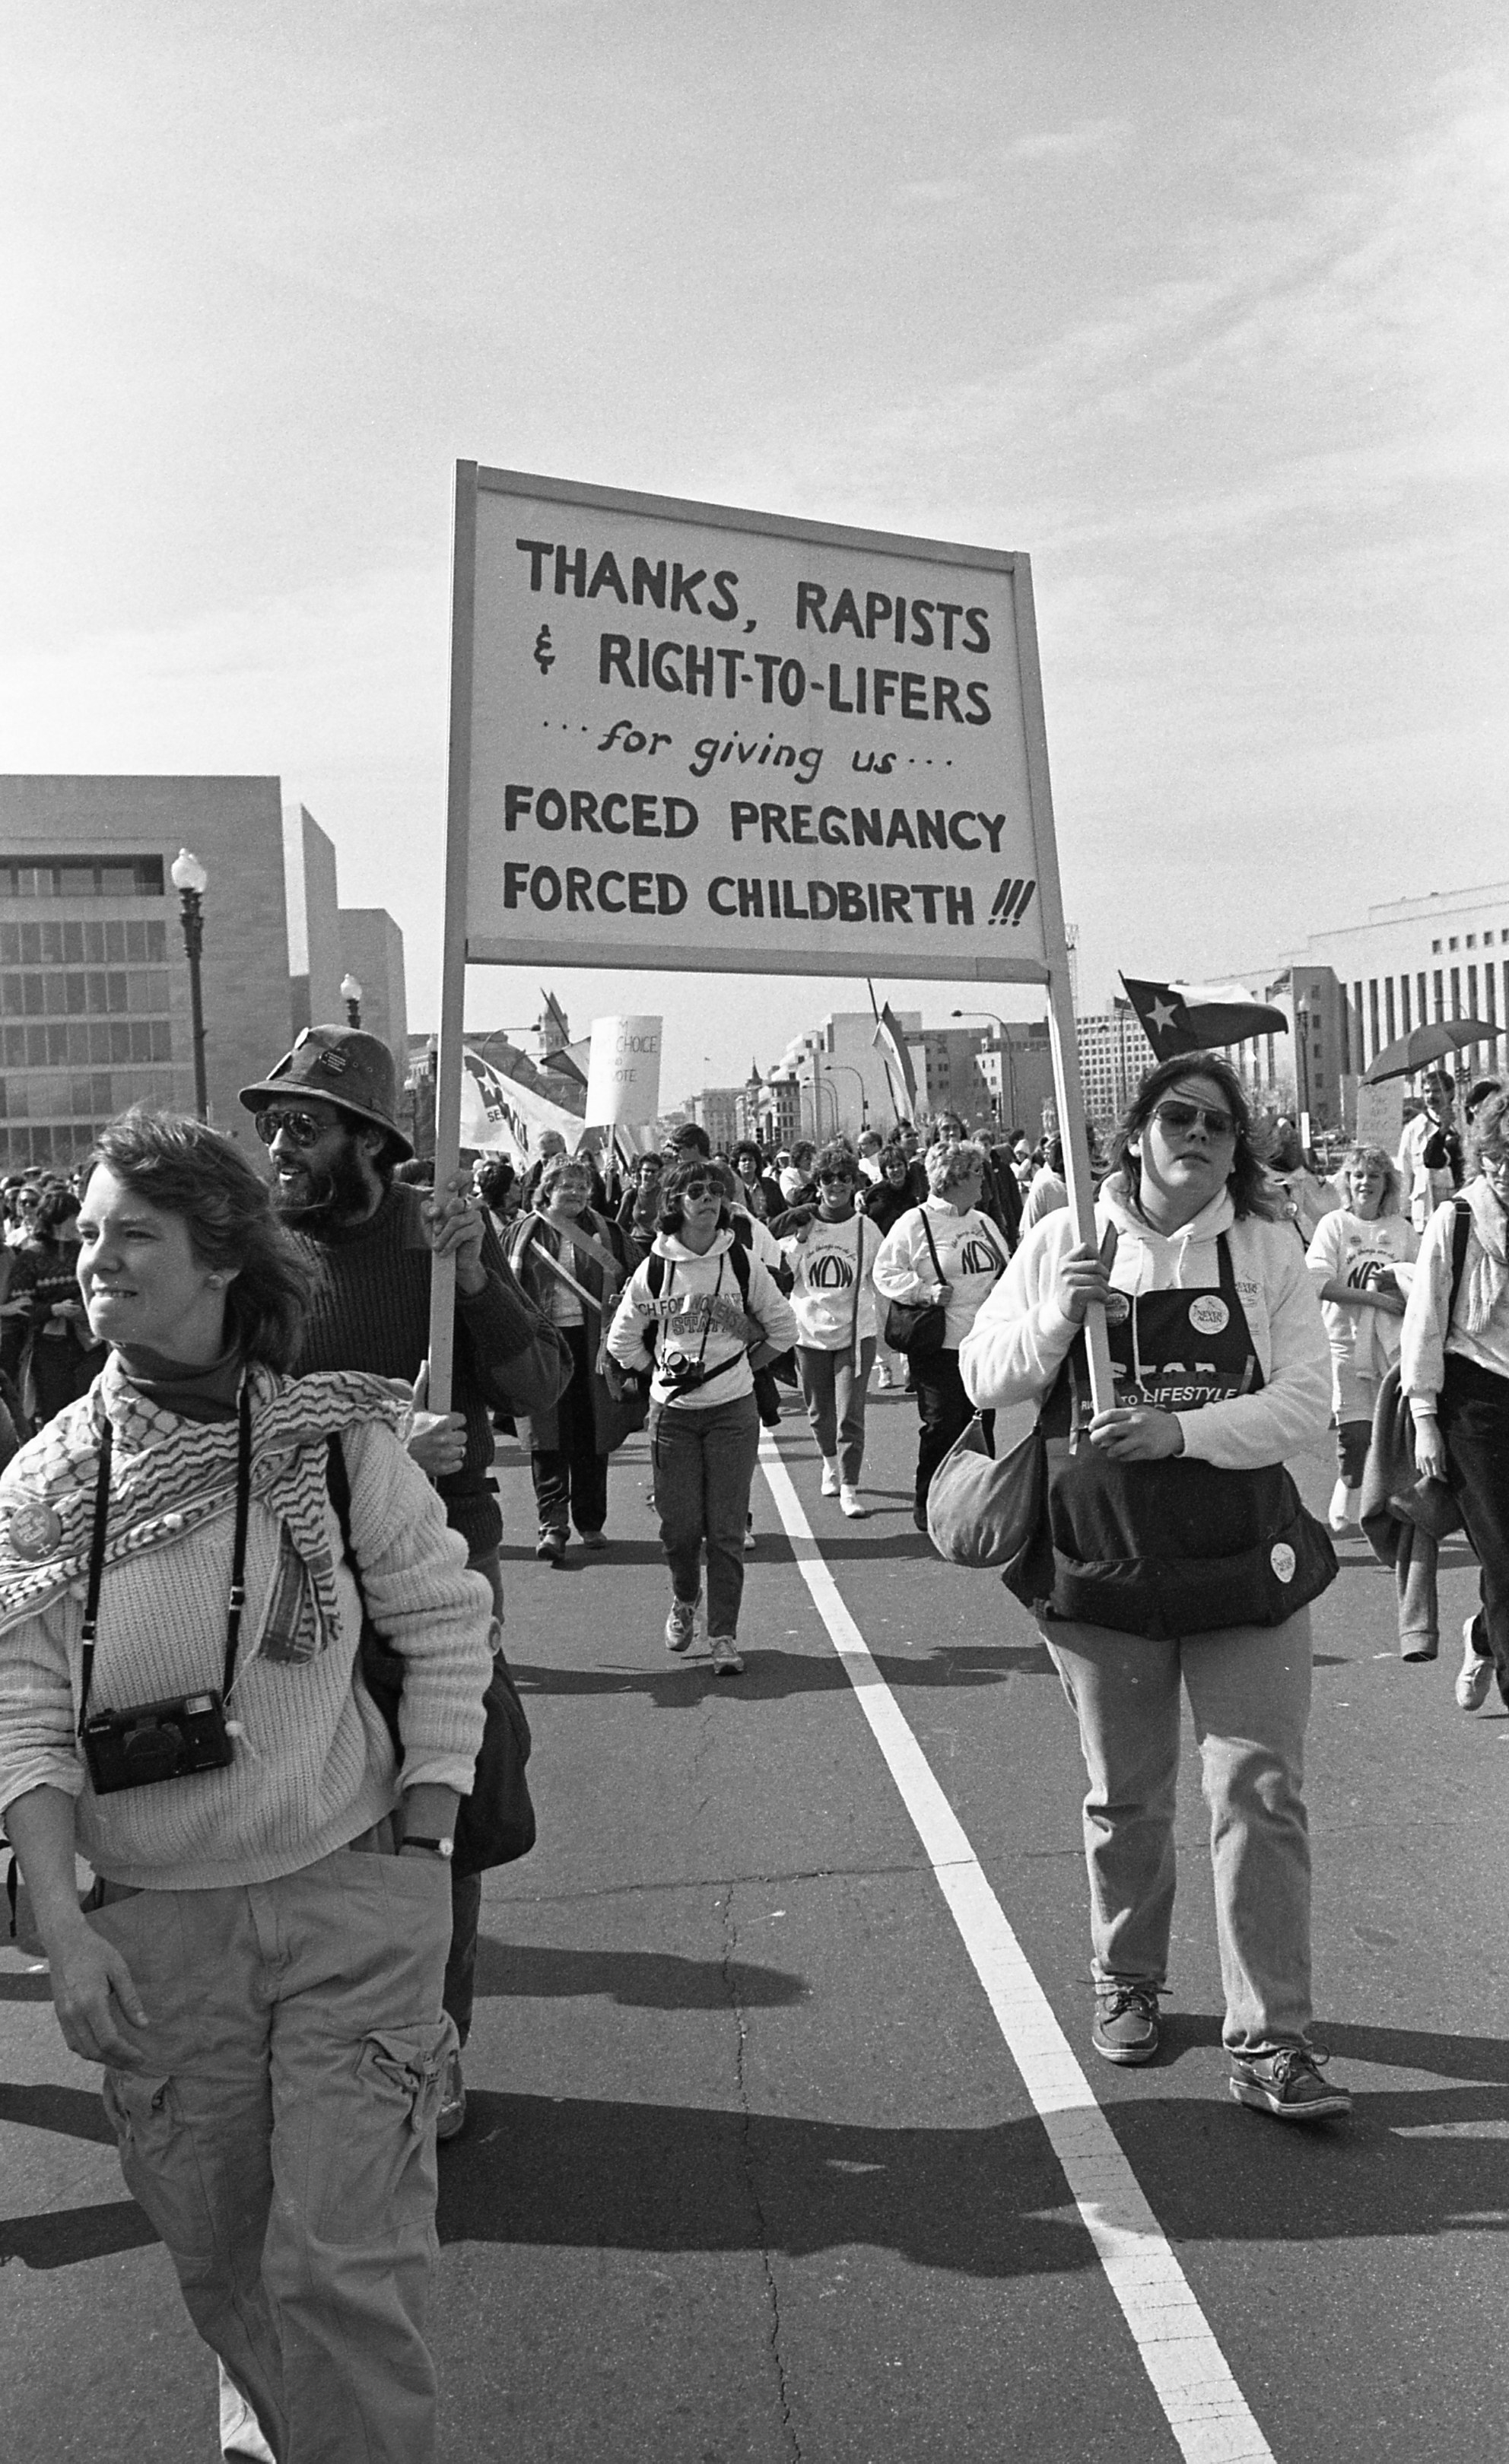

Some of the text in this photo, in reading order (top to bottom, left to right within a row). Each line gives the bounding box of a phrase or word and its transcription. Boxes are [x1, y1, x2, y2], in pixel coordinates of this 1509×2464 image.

[516, 538, 991, 654] THANKS, RAPISTS
[533, 624, 992, 726] & RIGHT-TO-LIFERS
[688, 730, 824, 785] giving
[504, 784, 1006, 853] FORCED PREGNANCY
[503, 862, 1037, 927] FORCED CHILDBIRTH !!!
[616, 1035, 658, 1053] CHOICE
[809, 1255, 853, 1288] NOW
[1120, 1394, 1138, 1405] TO
